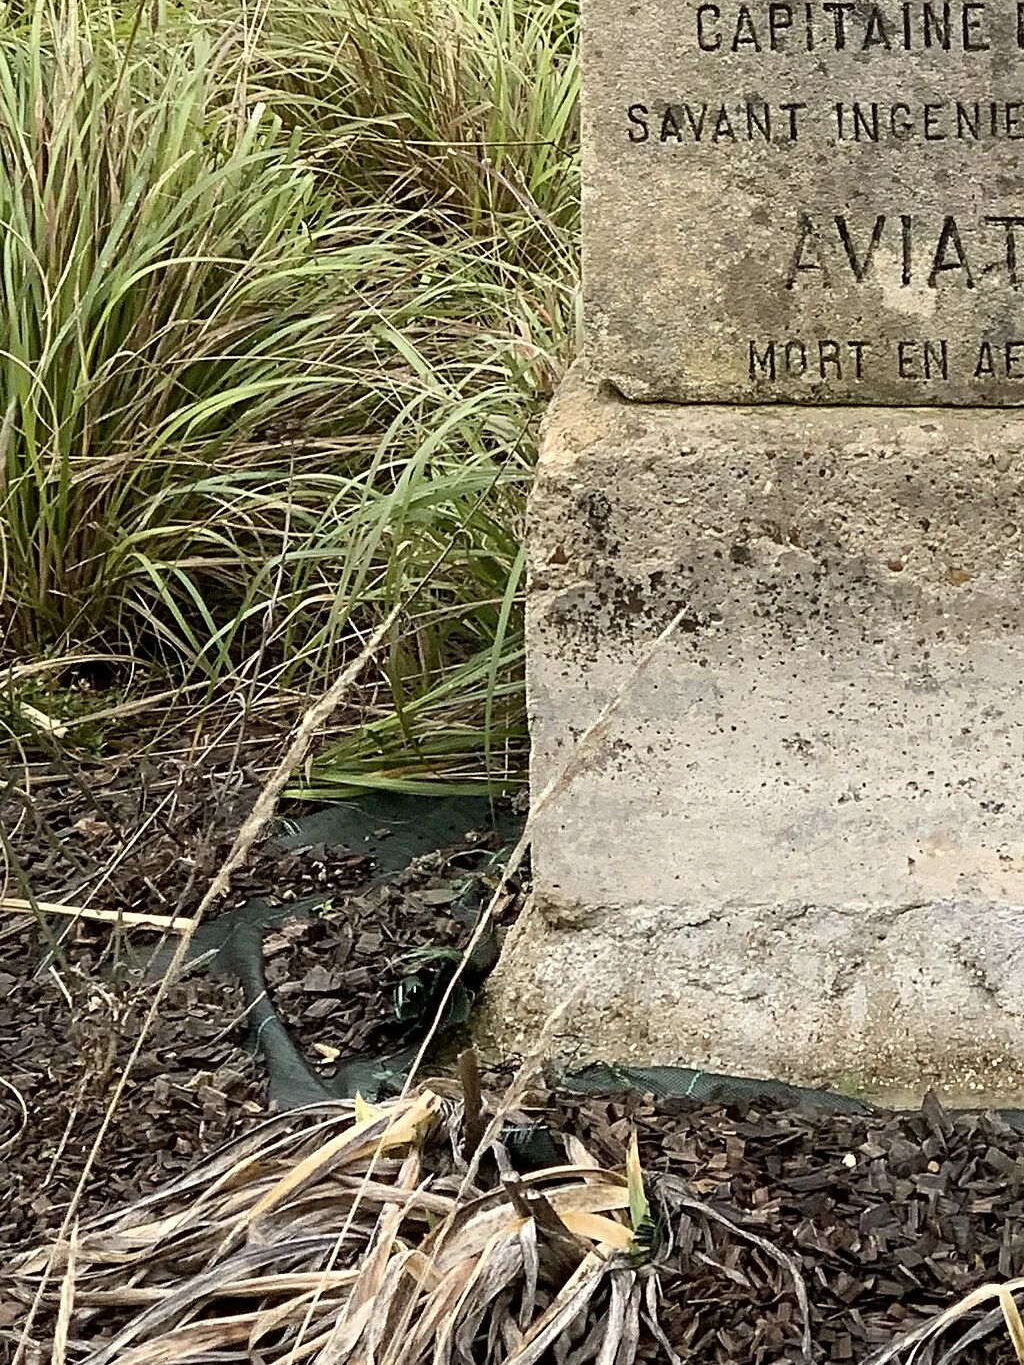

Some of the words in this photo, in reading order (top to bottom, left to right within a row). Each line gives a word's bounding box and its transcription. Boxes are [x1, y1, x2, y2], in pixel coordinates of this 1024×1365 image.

[696, 0, 991, 54] CAPITAINE
[627, 101, 804, 145] SAVANT
[748, 339, 869, 382] MORT
[897, 339, 950, 382] EN
